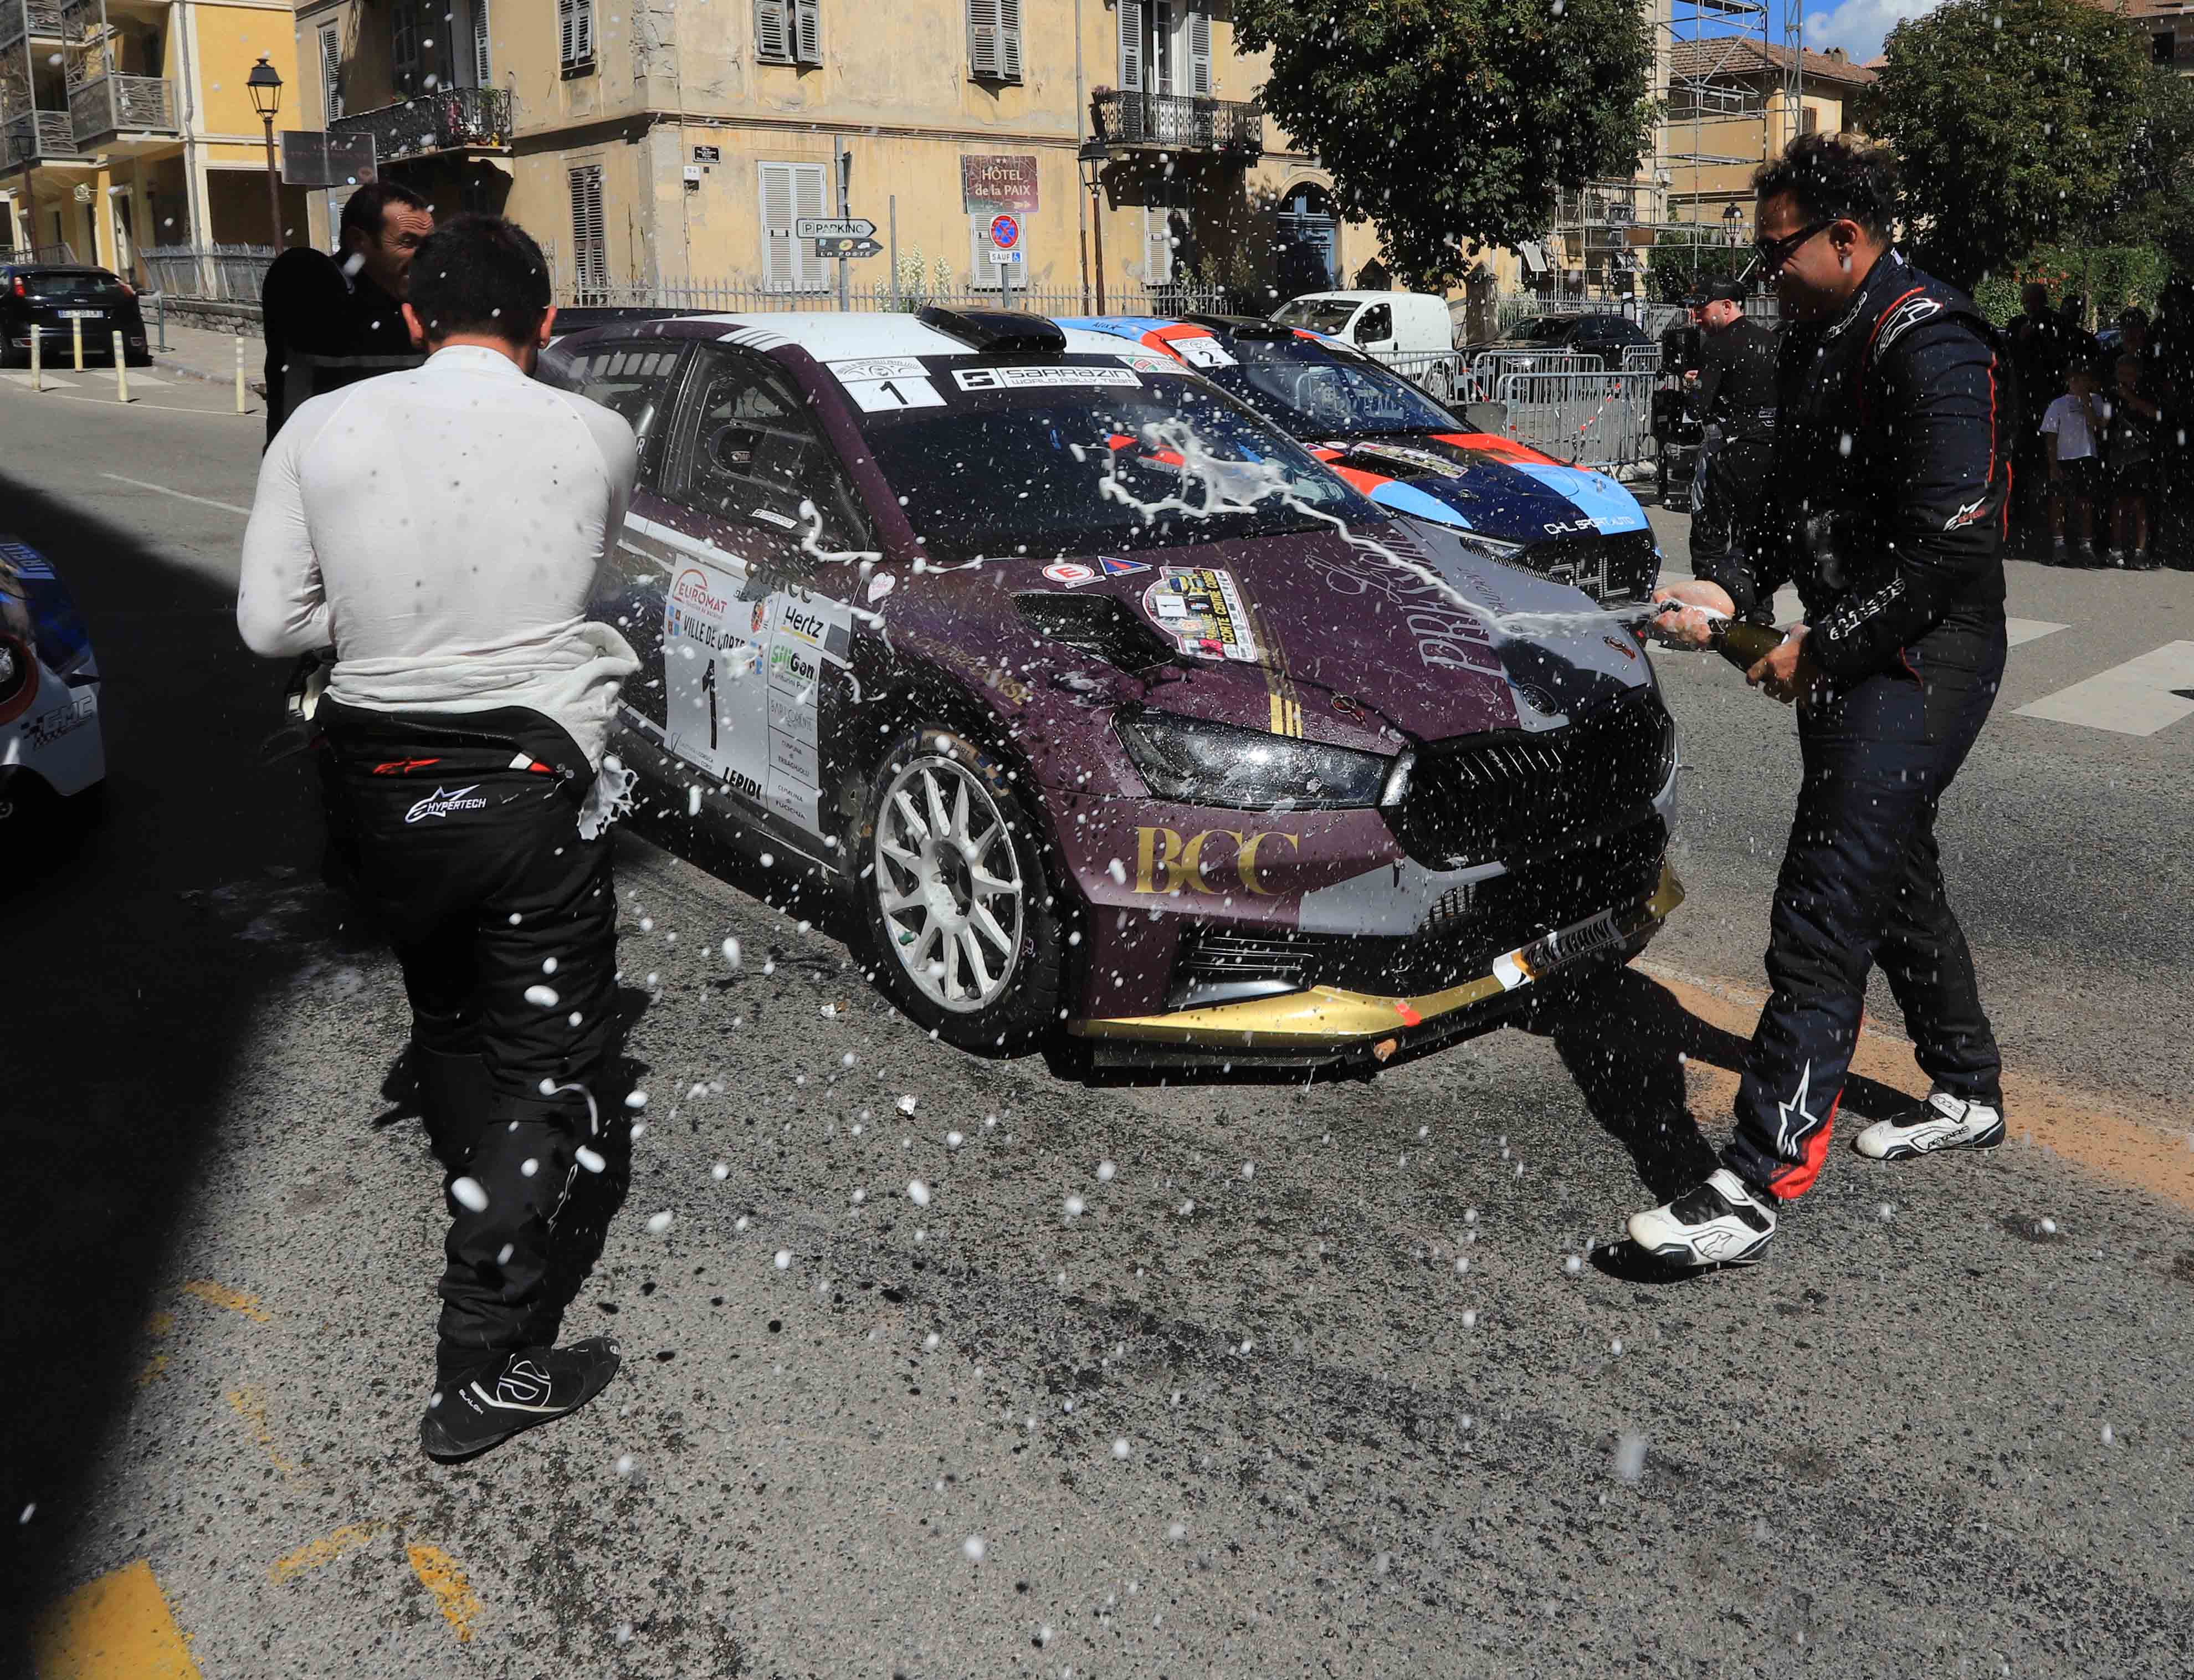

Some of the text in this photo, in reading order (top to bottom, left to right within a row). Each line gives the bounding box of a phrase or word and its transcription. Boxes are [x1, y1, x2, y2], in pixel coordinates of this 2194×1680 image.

[982, 166, 1024, 181] HÔTEL
[975, 184, 1031, 196] de la PAIX
[816, 224, 864, 234] PARKING
[1198, 350, 1222, 365] 2
[880, 381, 909, 405] 1
[1543, 522, 1578, 535] CHL
[1575, 518, 1606, 530] SPORT
[678, 582, 727, 613] EUROMAT
[683, 615, 705, 642] VILLE
[705, 626, 715, 648] DE
[785, 605, 824, 639] Hertz
[1216, 617, 1236, 644] CORTE
[701, 658, 717, 750] 1
[722, 766, 762, 800] LEPIDI
[427, 798, 488, 812] HYPERTECH
[1130, 825, 1299, 896] BCC
